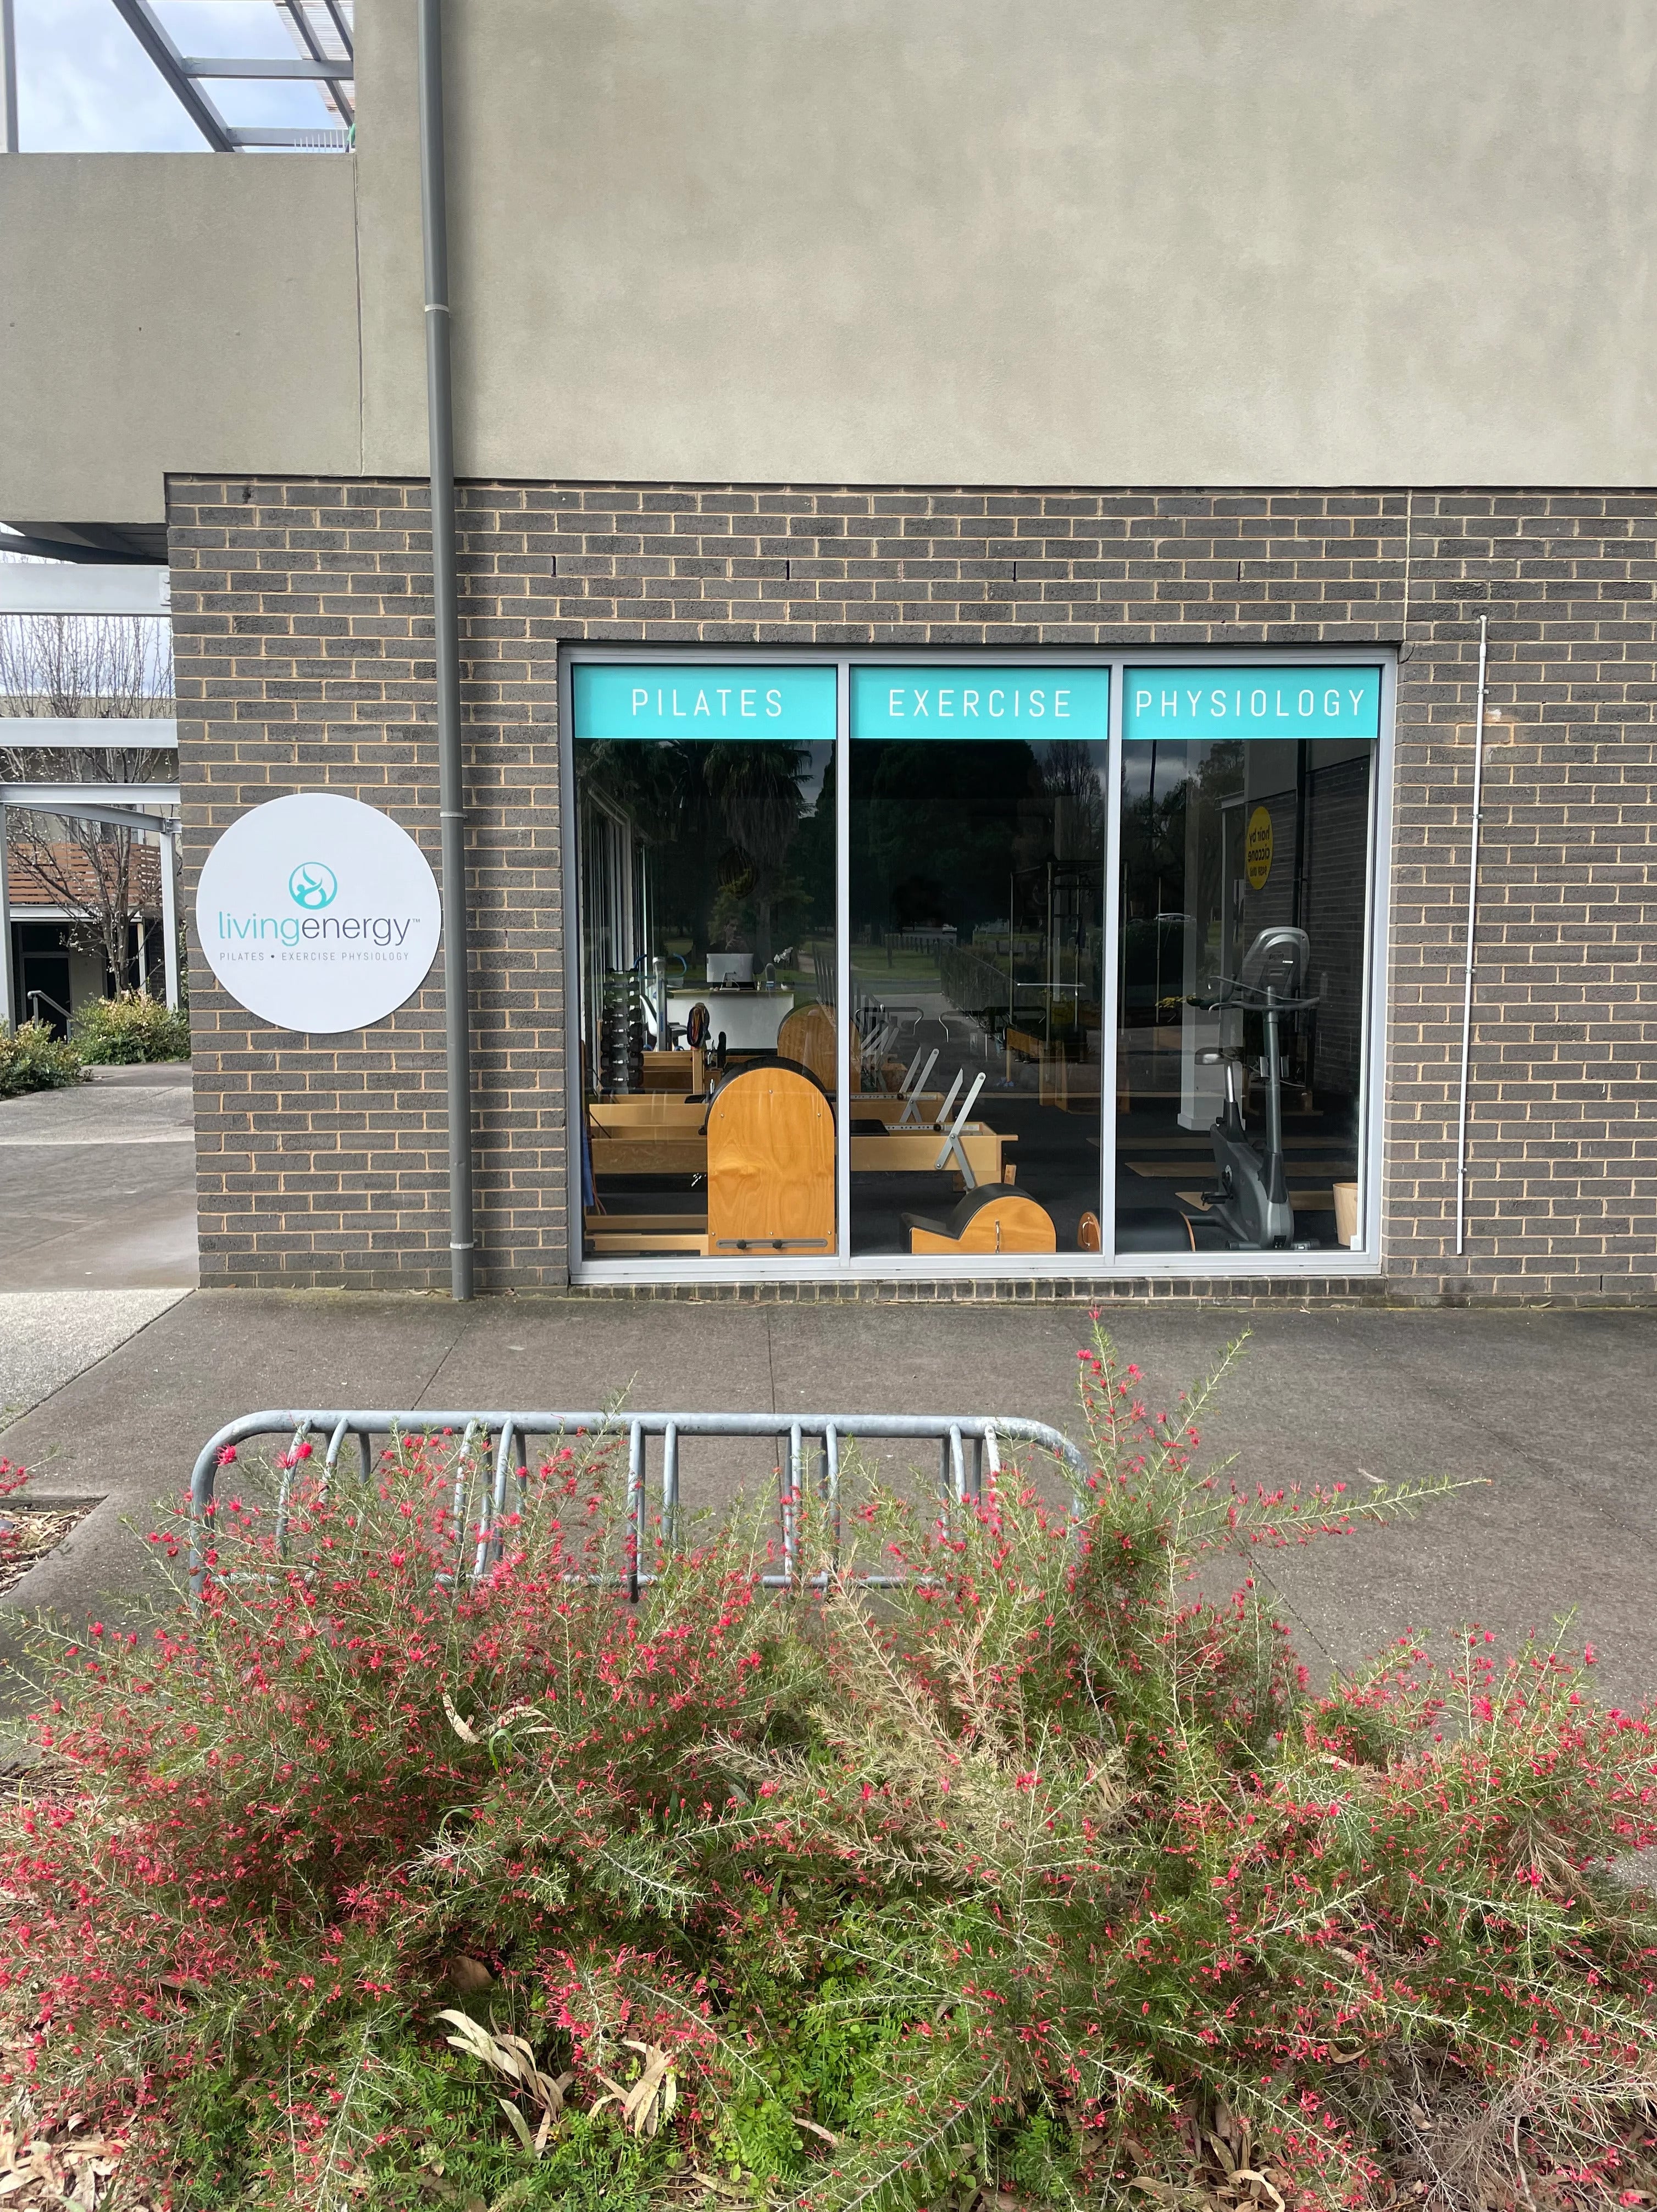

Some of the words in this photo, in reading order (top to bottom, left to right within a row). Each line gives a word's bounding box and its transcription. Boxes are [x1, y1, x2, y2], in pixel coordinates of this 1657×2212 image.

[633, 689, 782, 716] PILATES
[890, 689, 1070, 716] EXERCISE
[1137, 689, 1364, 716] PHYSIOLOGY
[220, 952, 264, 961] PILATES
[281, 952, 335, 961] EXERCISE
[342, 952, 408, 961] PHYSIOLOGY
